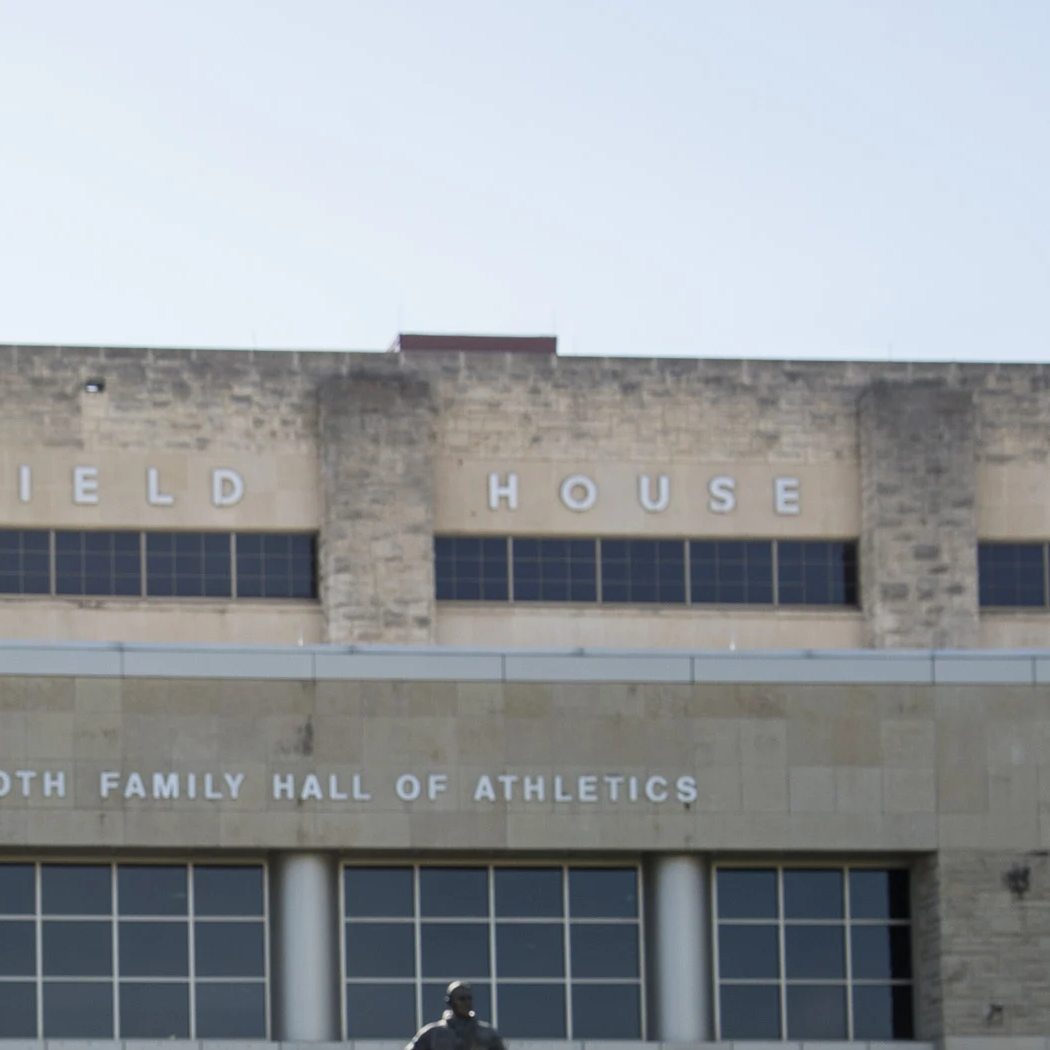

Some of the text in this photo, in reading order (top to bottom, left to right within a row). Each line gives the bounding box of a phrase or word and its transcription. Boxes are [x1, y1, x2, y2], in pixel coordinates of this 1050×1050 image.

[487, 472, 800, 515] HOUSE
[100, 771, 245, 800] FAMILY
[272, 773, 371, 801] HALL
[395, 774, 447, 801] OF
[473, 774, 699, 803] ATHLETICS
